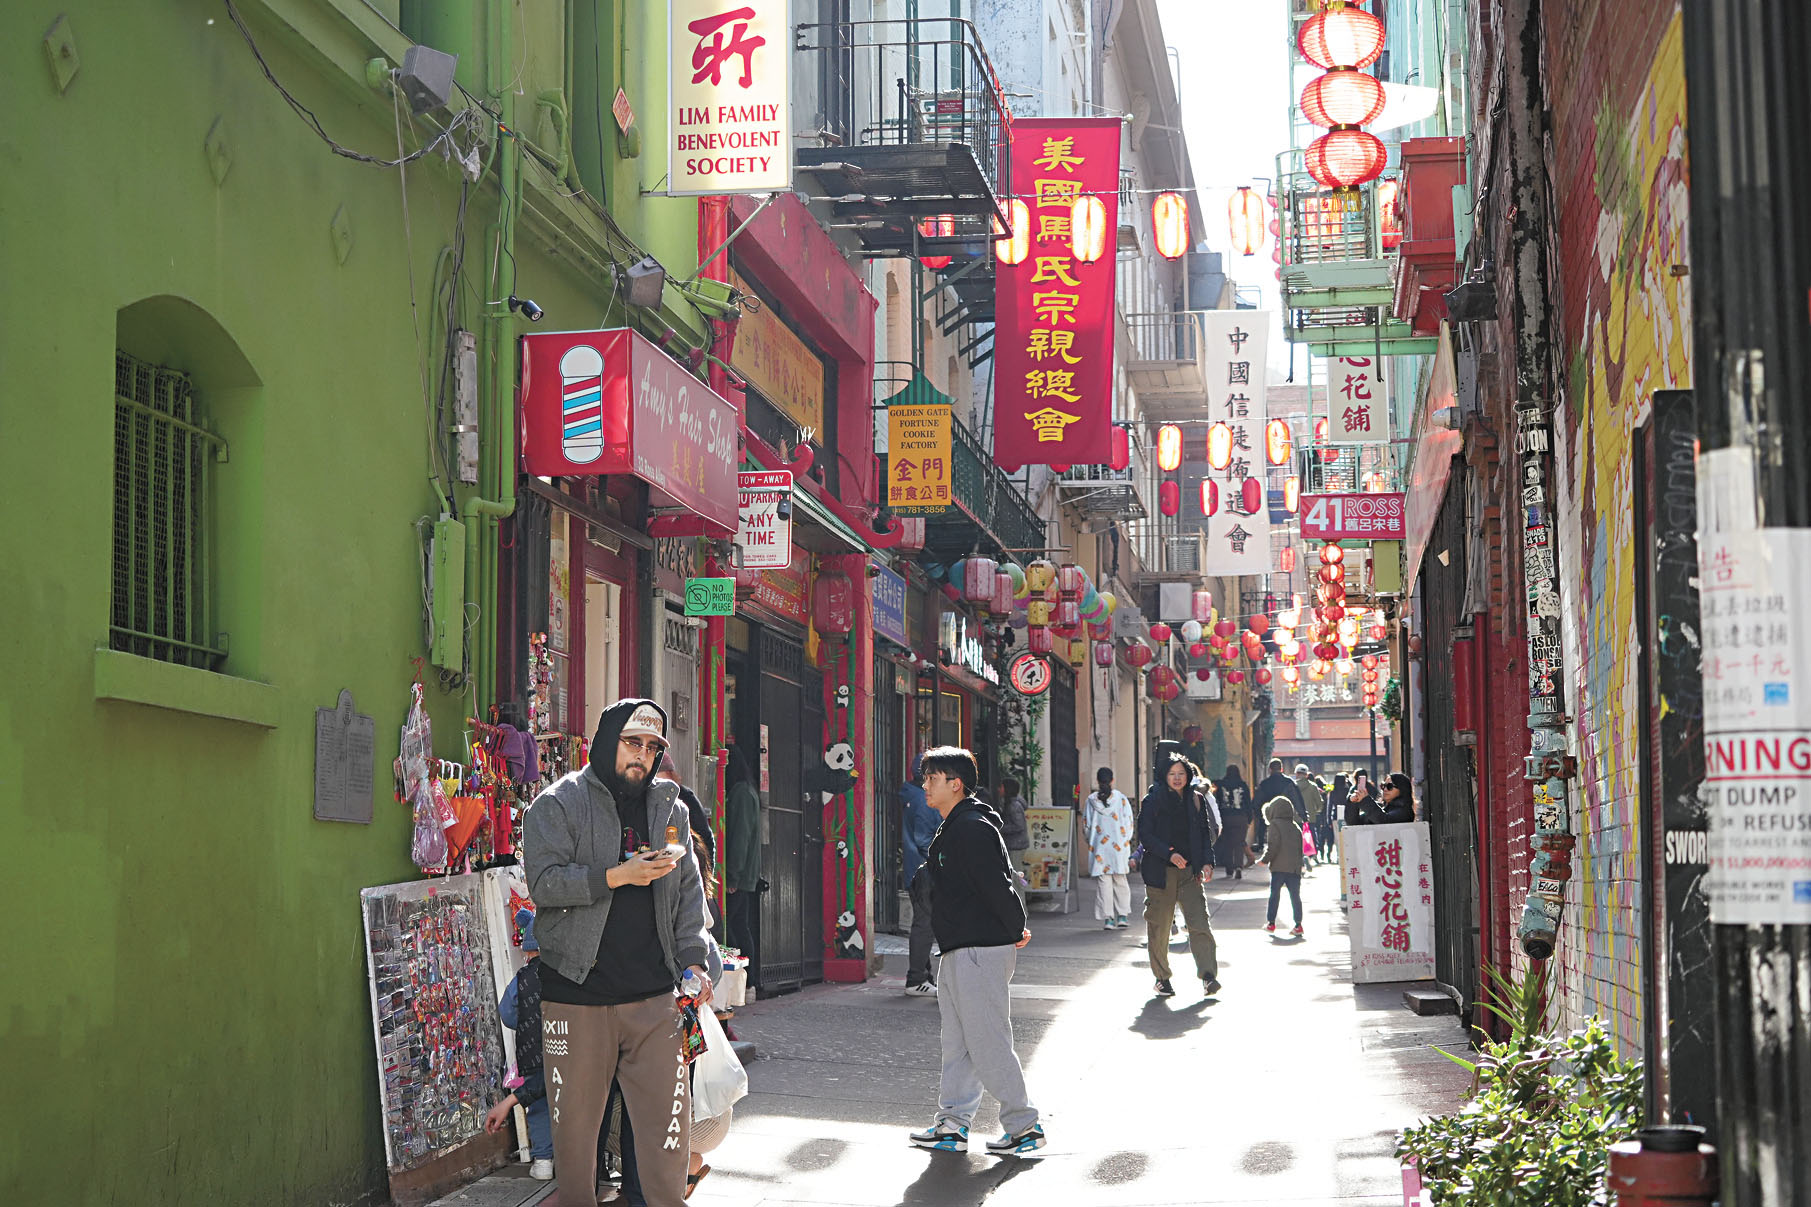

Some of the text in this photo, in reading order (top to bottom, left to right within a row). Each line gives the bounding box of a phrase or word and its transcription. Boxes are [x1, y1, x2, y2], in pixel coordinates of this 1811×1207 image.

[679, 103, 779, 125] LIM FAMILY
[677, 130, 780, 151] BENEVOLENT
[686, 156, 771, 176] SOCIETY
[638, 359, 733, 477] Amy's Hair Shop
[890, 408, 949, 417] GOLDEN GATE
[899, 419, 939, 428] FORTUNE
[903, 430, 935, 438] COOKIE
[900, 441, 938, 449] FACTORY
[894, 457, 943, 481] 金門
[750, 492, 782, 504] PARKIN
[890, 485, 948, 500] 餅食公司
[907, 505, 946, 514] 781-3856
[1305, 497, 1401, 532] 41 ROSS
[747, 513, 774, 528] ANY
[1344, 518, 1401, 532] 舊呂宋巷
[745, 531, 776, 545] TIME
[1527, 535, 1546, 546] 419
[712, 584, 724, 592] NO
[712, 592, 733, 602] PHOTOS
[712, 602, 732, 611] PLEASE
[1727, 786, 1796, 807] DUMP
[1744, 837, 1787, 849] ARREST
[552, 1066, 563, 1124] AIR
